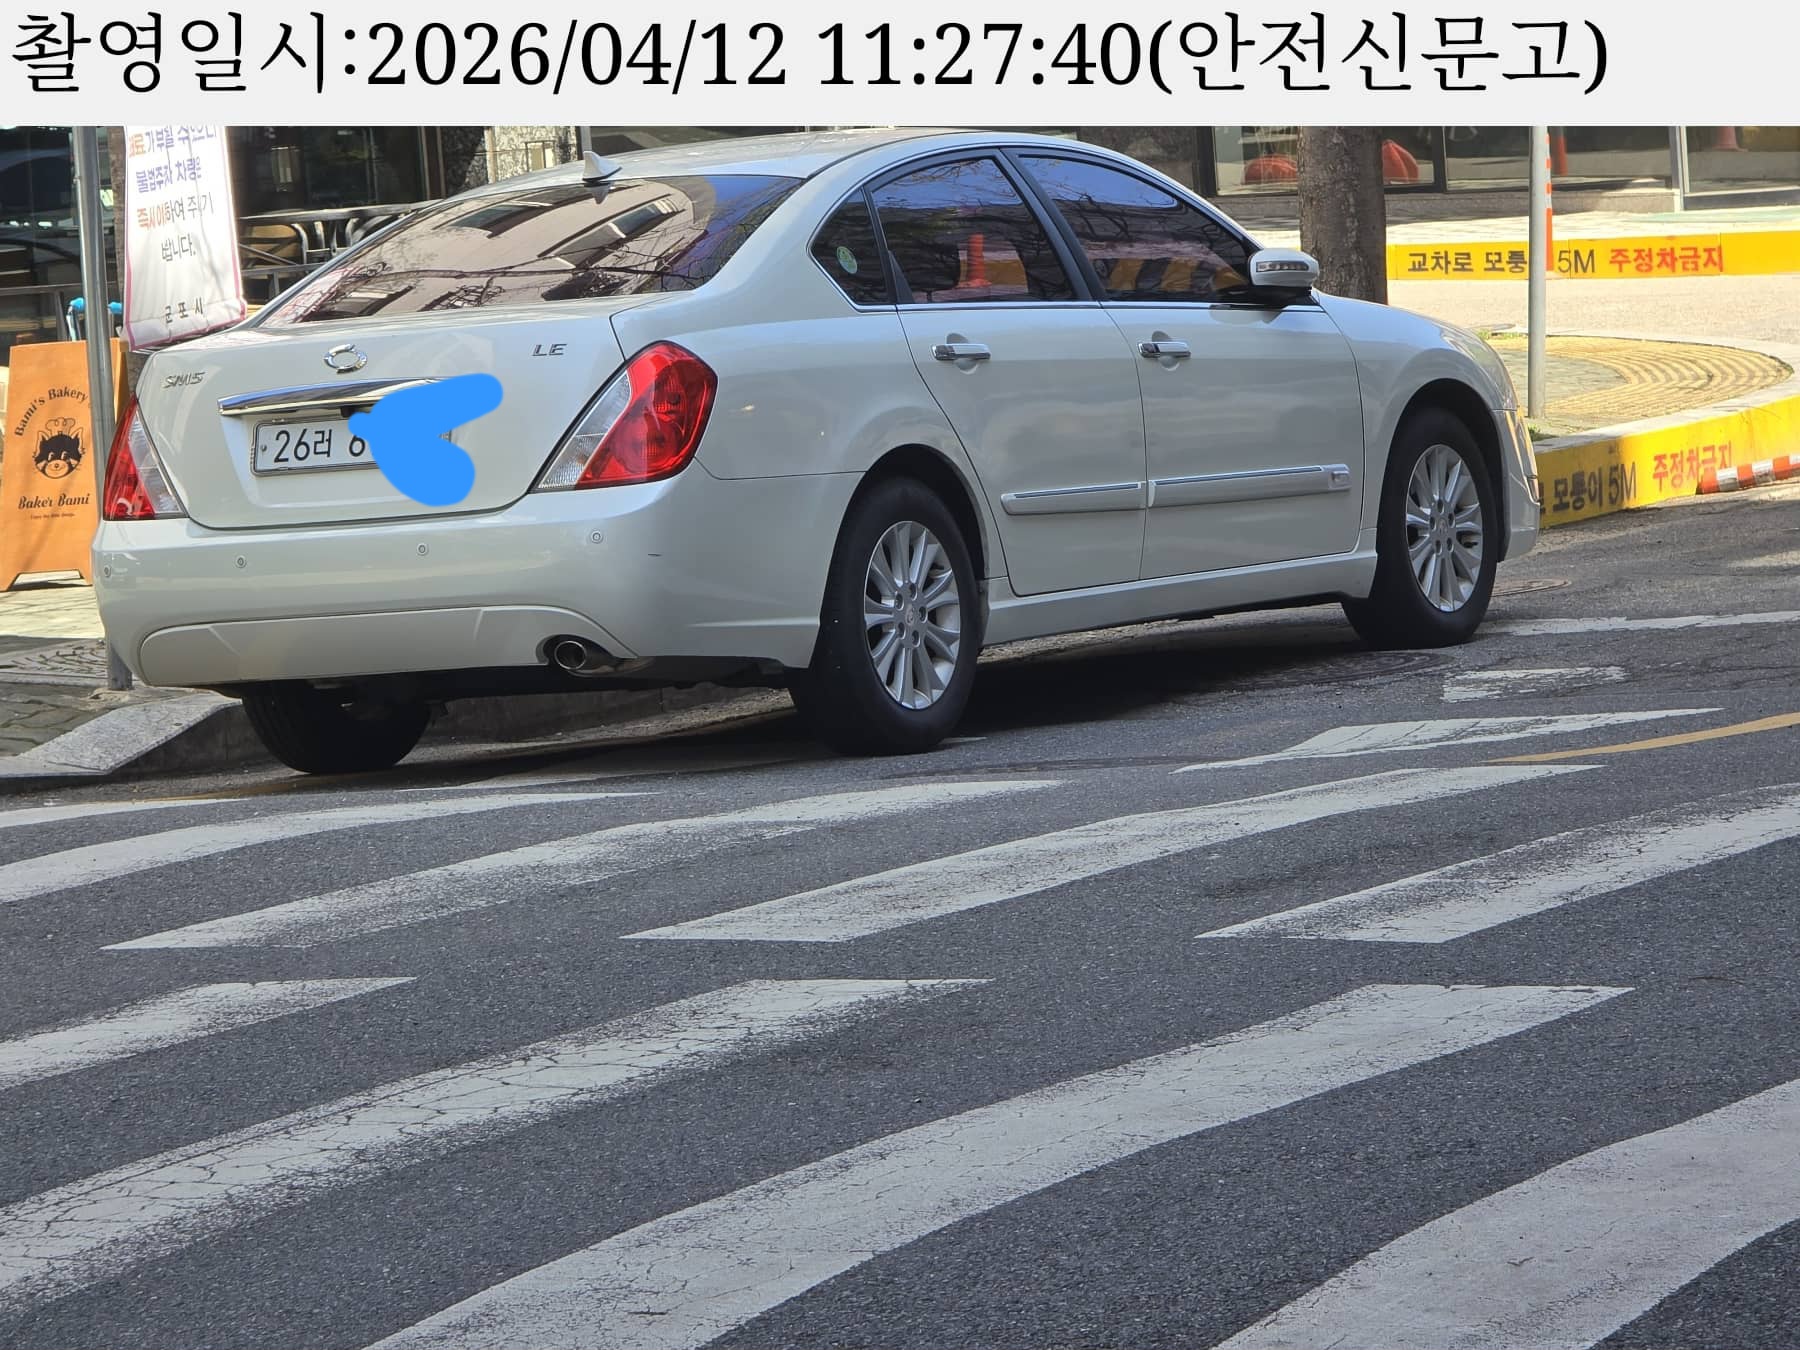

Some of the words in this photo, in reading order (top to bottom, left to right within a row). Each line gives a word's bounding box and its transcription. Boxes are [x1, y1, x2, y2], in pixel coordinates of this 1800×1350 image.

[1408, 250, 1473, 274] 교차로
[1484, 250, 1528, 273] 모퉁
[1558, 249, 1595, 273] 5M
[1609, 245, 1723, 272] 주정차금지
[532, 343, 567, 357] LE
[163, 369, 206, 388] SM5
[14, 397, 45, 436] Bami's
[48, 386, 88, 404] Bakery
[274, 428, 332, 463] 26러
[58, 493, 90, 506] Bami
[1552, 468, 1602, 511] 모퉁이
[1608, 461, 1637, 505] 5M
